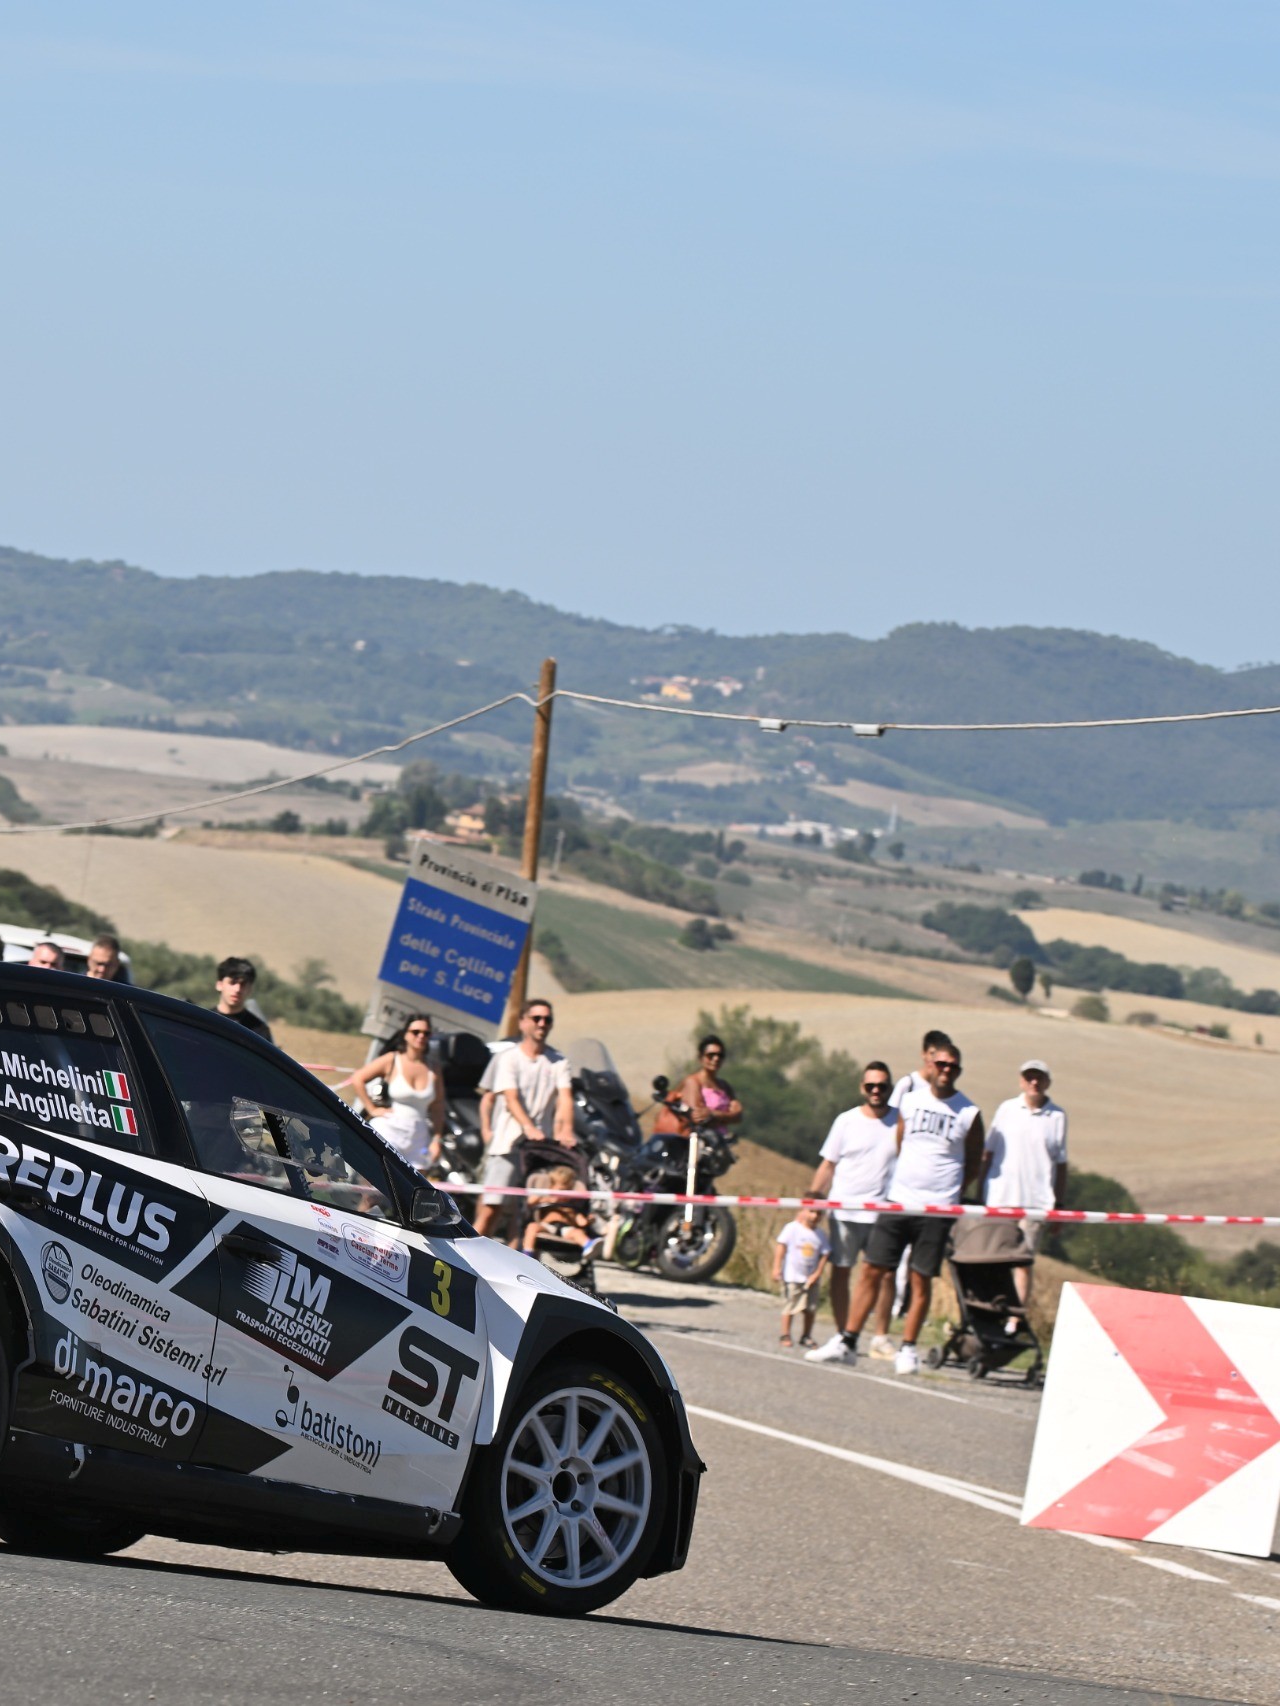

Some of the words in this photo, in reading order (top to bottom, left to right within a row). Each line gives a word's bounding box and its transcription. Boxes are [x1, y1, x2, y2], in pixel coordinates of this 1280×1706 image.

[419, 854, 477, 887] Provincia
[480, 881, 494, 894] di
[495, 885, 529, 907] PISA
[407, 897, 446, 924] Strada
[450, 914, 516, 950] Provinciale
[399, 932, 441, 958] delle
[444, 949, 505, 983] Colline
[399, 960, 429, 977] per
[453, 976, 494, 1004] Luce
[65, 1212, 77, 1223] THE
[77, 1218, 115, 1242] EXPERIENCE
[115, 1237, 128, 1248] FOR
[128, 1243, 164, 1266] INNOVATION
[351, 1240, 379, 1261] Casciana
[380, 1255, 399, 1272] Terme
[81, 1263, 171, 1323] Oleodinamica
[430, 1259, 453, 1317] 3
[71, 1288, 139, 1339] Sabatini
[138, 1325, 203, 1373] Sistemi
[201, 1363, 228, 1386] srl
[235, 1309, 277, 1339] TRASPORTI
[276, 1333, 325, 1366] ECCEZIONALI
[266, 1308, 332, 1355] TRASPORTI
[296, 1307, 333, 1337] LENZI
[78, 1357, 196, 1437] marco
[388, 1325, 480, 1423] ST
[50, 1389, 106, 1423] FORNITURE
[106, 1414, 167, 1449] INDUSTRIALI
[300, 1431, 328, 1450] ARTICOLI
[327, 1446, 340, 1456] PER
[301, 1401, 382, 1468] batistoni
[385, 1397, 455, 1445] MACCHINE
